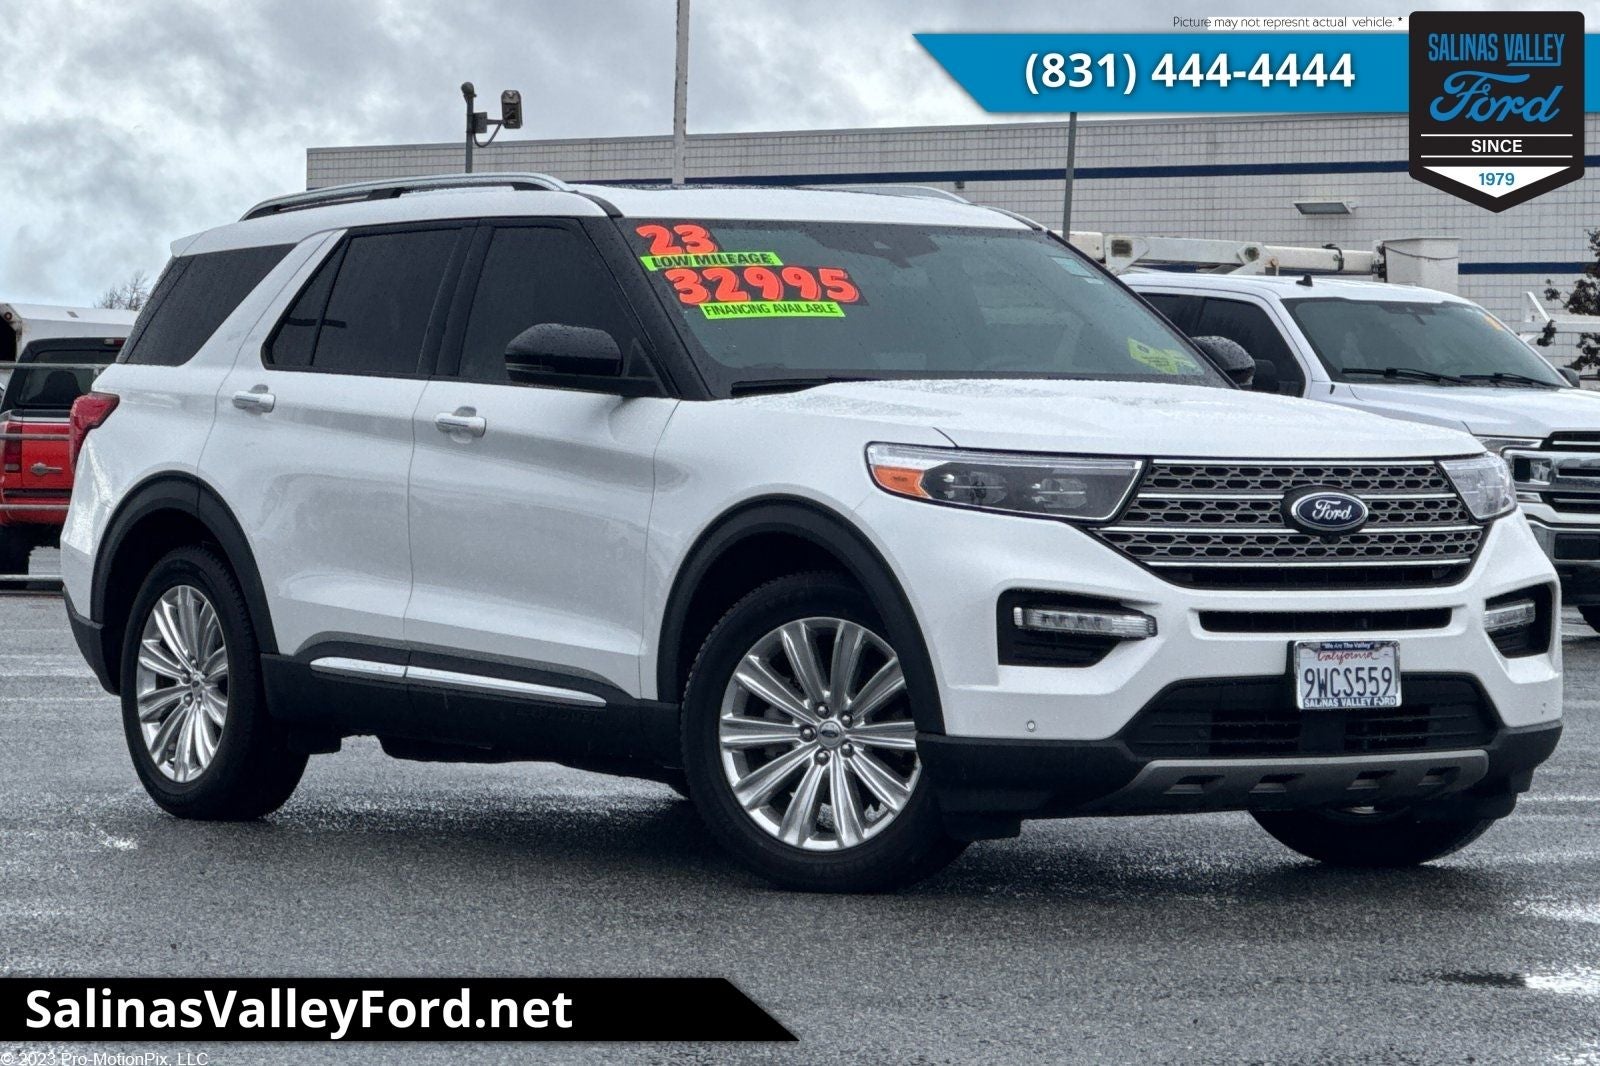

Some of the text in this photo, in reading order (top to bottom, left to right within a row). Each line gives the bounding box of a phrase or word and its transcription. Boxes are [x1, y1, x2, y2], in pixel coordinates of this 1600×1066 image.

[636, 224, 719, 255] 23
[652, 253, 773, 268] LOW MILEAGE
[664, 266, 859, 305] 32995
[704, 302, 837, 316] FINANCING AVAILABLE
[1312, 499, 1352, 520] Ford
[1317, 650, 1379, 665] California
[1304, 666, 1393, 698] 9WCS559
[1304, 696, 1396, 708] SALINAS VALLEY FORD
